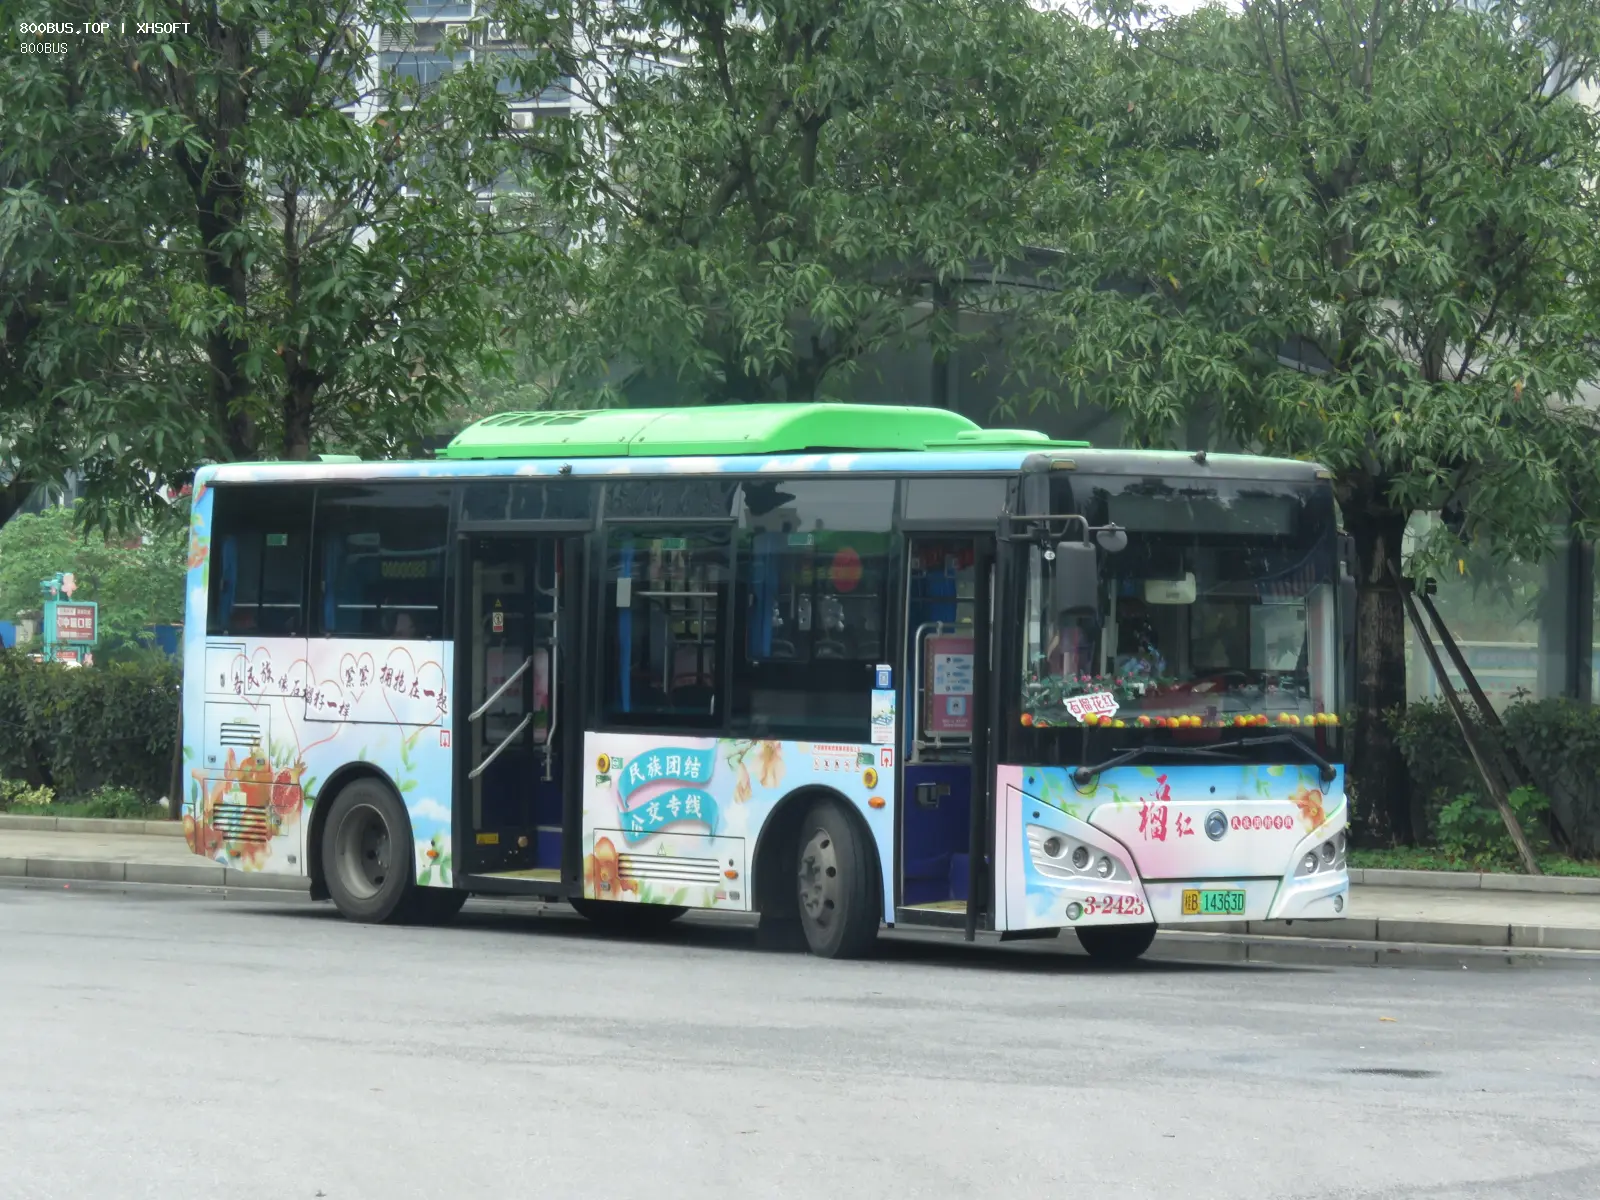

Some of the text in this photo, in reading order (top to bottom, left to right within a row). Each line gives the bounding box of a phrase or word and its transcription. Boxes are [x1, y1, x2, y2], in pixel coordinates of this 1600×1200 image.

[629, 754, 702, 786] 民族团结
[630, 794, 703, 838] 公交专线
[1083, 894, 1145, 916] 3-2423
